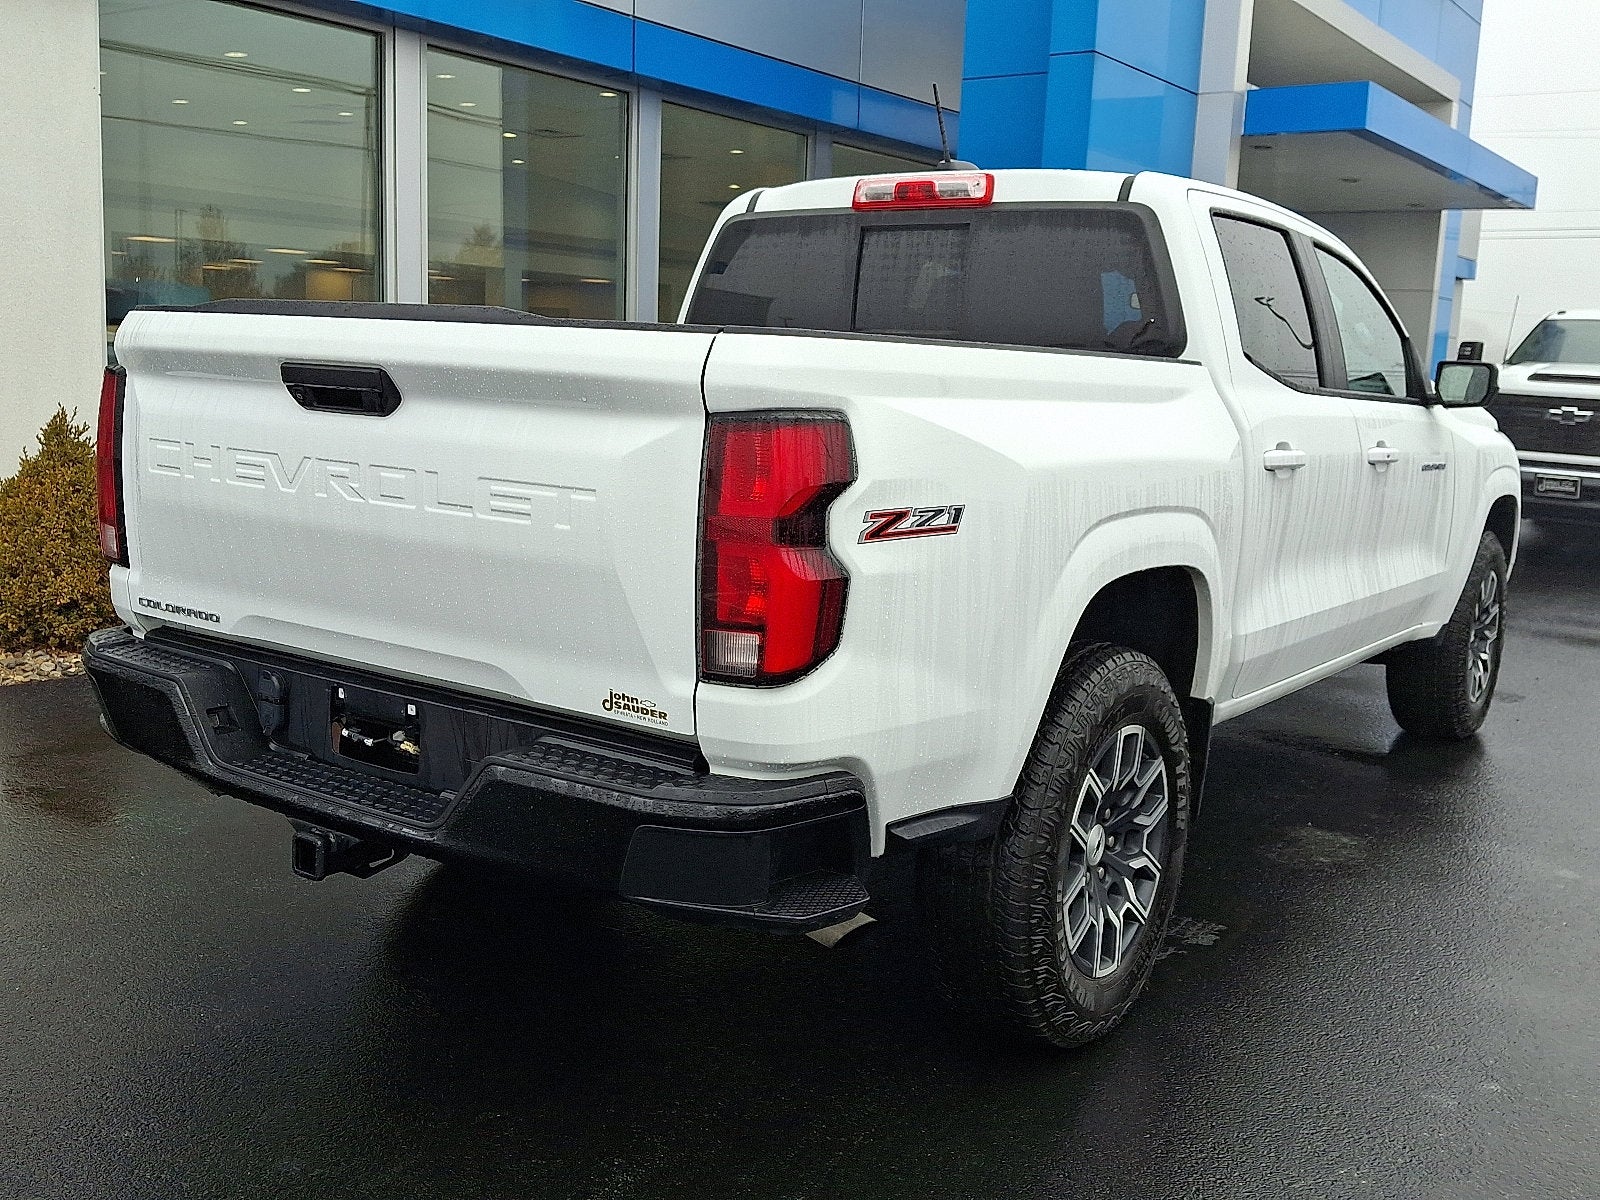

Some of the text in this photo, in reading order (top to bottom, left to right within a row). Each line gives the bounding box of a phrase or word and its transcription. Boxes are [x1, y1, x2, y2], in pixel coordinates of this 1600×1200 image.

[148, 437, 597, 530] CHEVROLET
[857, 504, 966, 544] Z71
[138, 597, 221, 623] COLORADO
[613, 700, 668, 721] SAUDER
